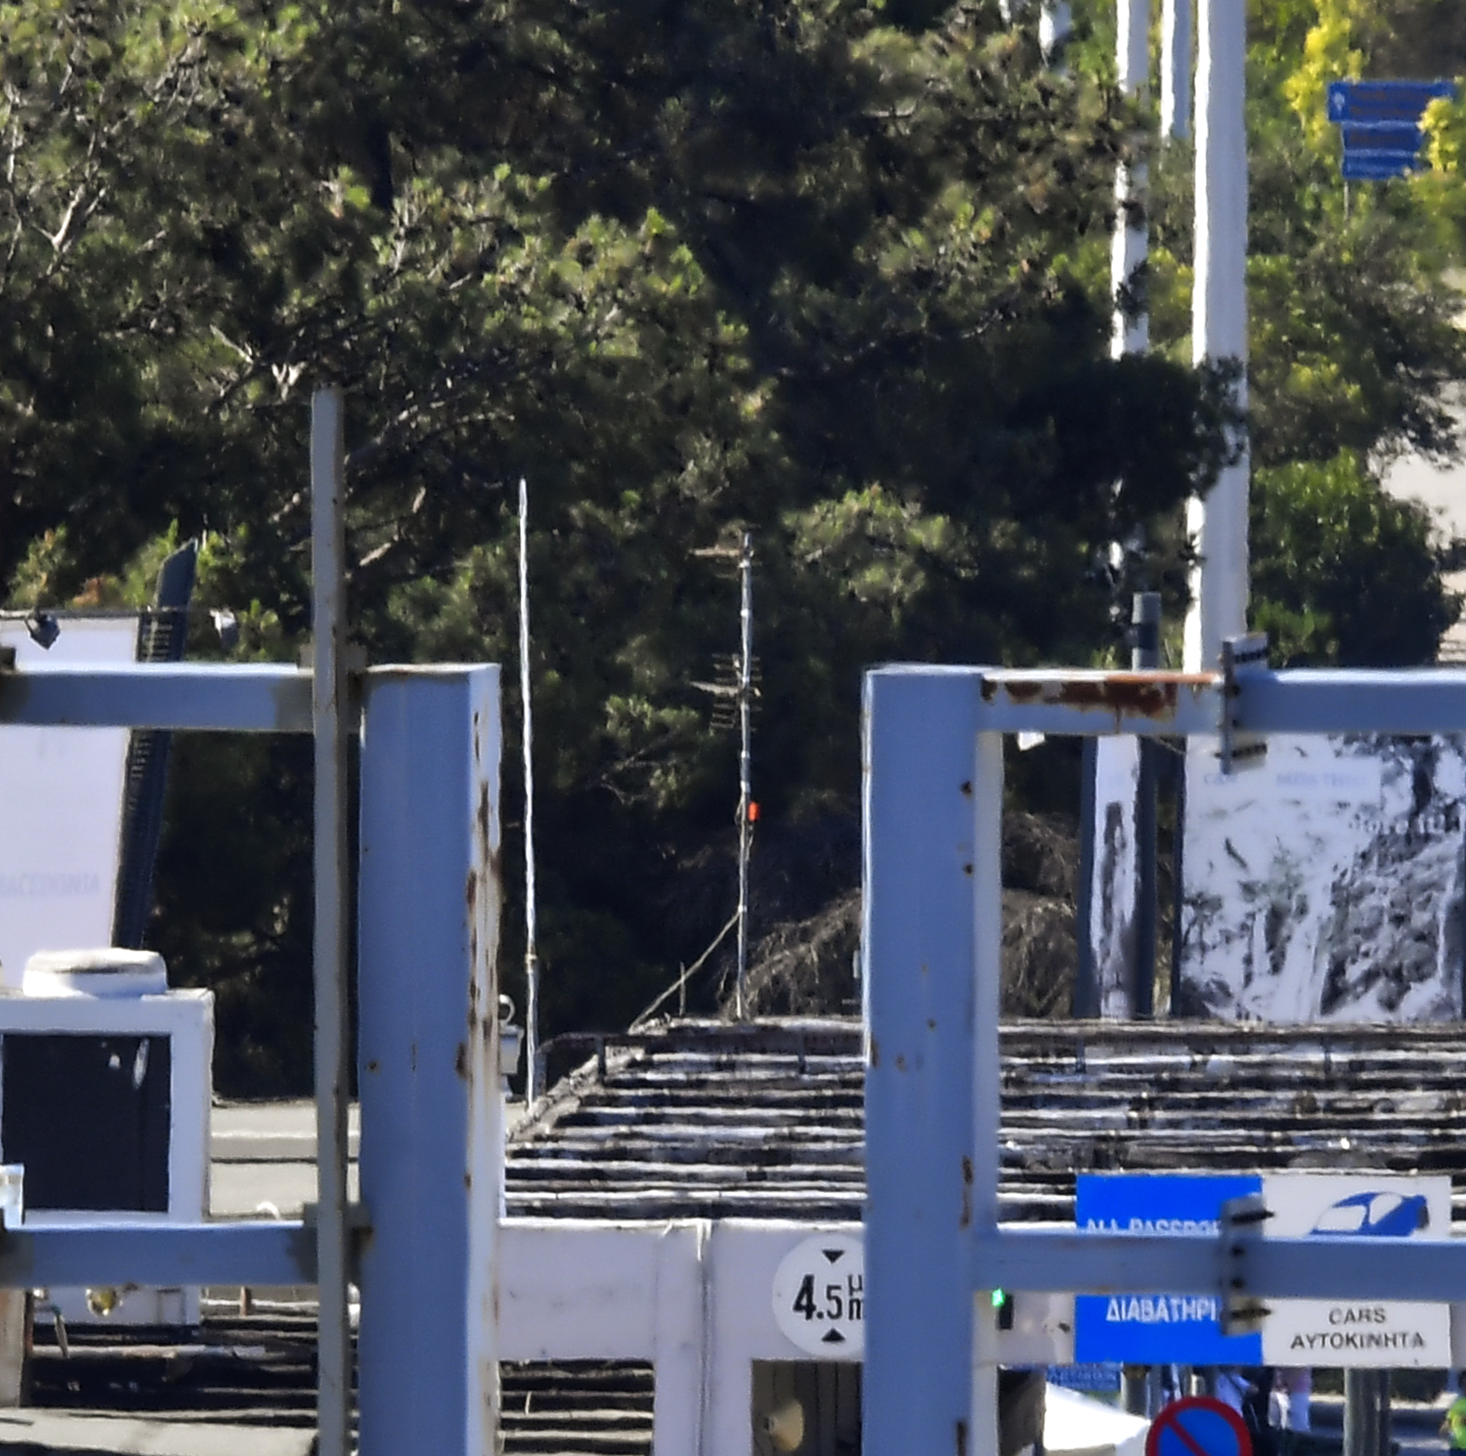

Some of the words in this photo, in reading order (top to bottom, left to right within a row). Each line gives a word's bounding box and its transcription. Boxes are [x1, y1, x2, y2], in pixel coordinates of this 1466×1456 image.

[1105, 1297, 1217, 1323] ΔΙΑΒΑΤΗΡΙ
[1328, 1307, 1387, 1325] CARS
[1290, 1331, 1425, 1350] ΑΥΤΟΚΙΝΗΤΑ
